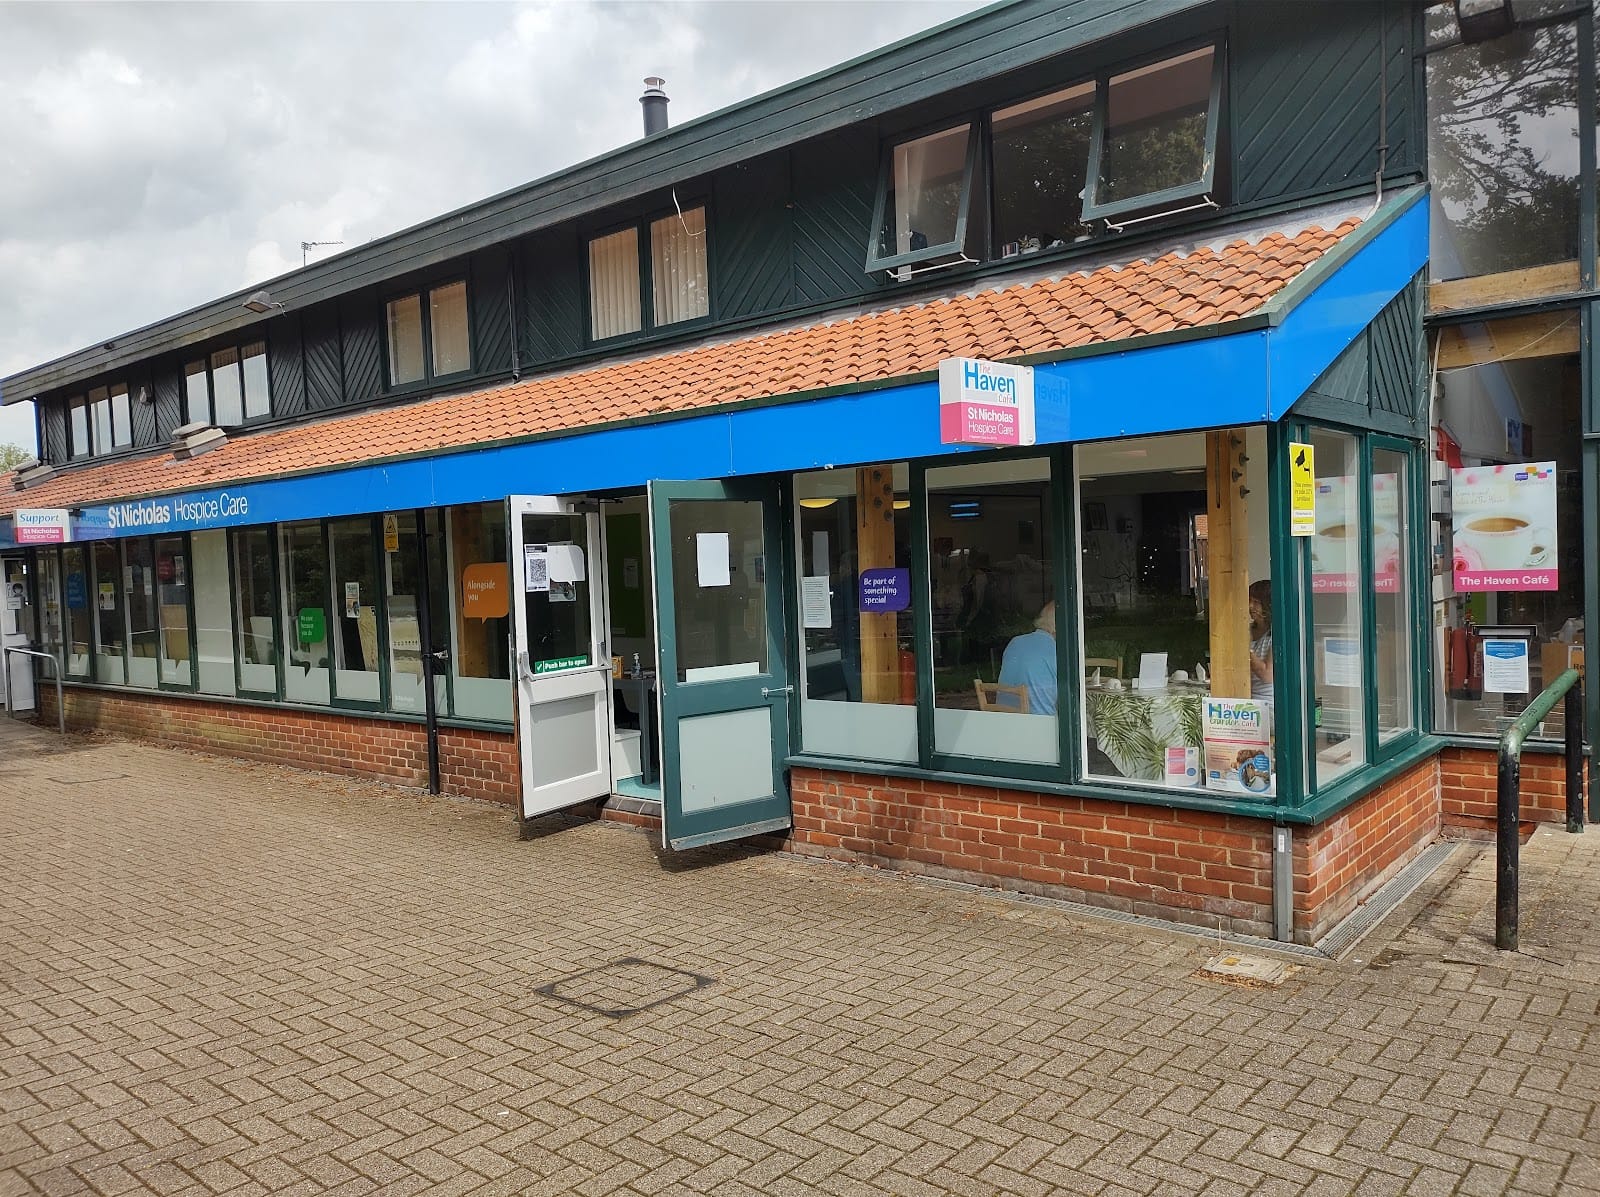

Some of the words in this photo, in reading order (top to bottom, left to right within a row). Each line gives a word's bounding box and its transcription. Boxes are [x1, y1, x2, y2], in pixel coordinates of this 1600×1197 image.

[964, 361, 1016, 404] Haven
[968, 407, 977, 420] St
[978, 408, 1014, 423] Nicholas
[968, 422, 997, 435] Hospice
[997, 424, 1014, 436] Care
[108, 506, 120, 529] St
[121, 501, 170, 526] Nicholas
[175, 498, 218, 524] Hospice
[220, 493, 248, 515] Care
[19, 513, 60, 525] Support
[863, 577, 872, 586] Be
[872, 578, 887, 588] part
[887, 576, 897, 585] of
[1460, 577, 1481, 585] The
[1483, 576, 1519, 585] Haven
[1519, 574, 1550, 584] Café
[467, 579, 496, 593] Alongside
[863, 586, 897, 596] something
[468, 593, 479, 604] you
[864, 596, 887, 605] special
[545, 662, 558, 670] Push
[574, 659, 587, 668] open
[1208, 703, 1260, 727] Haven
